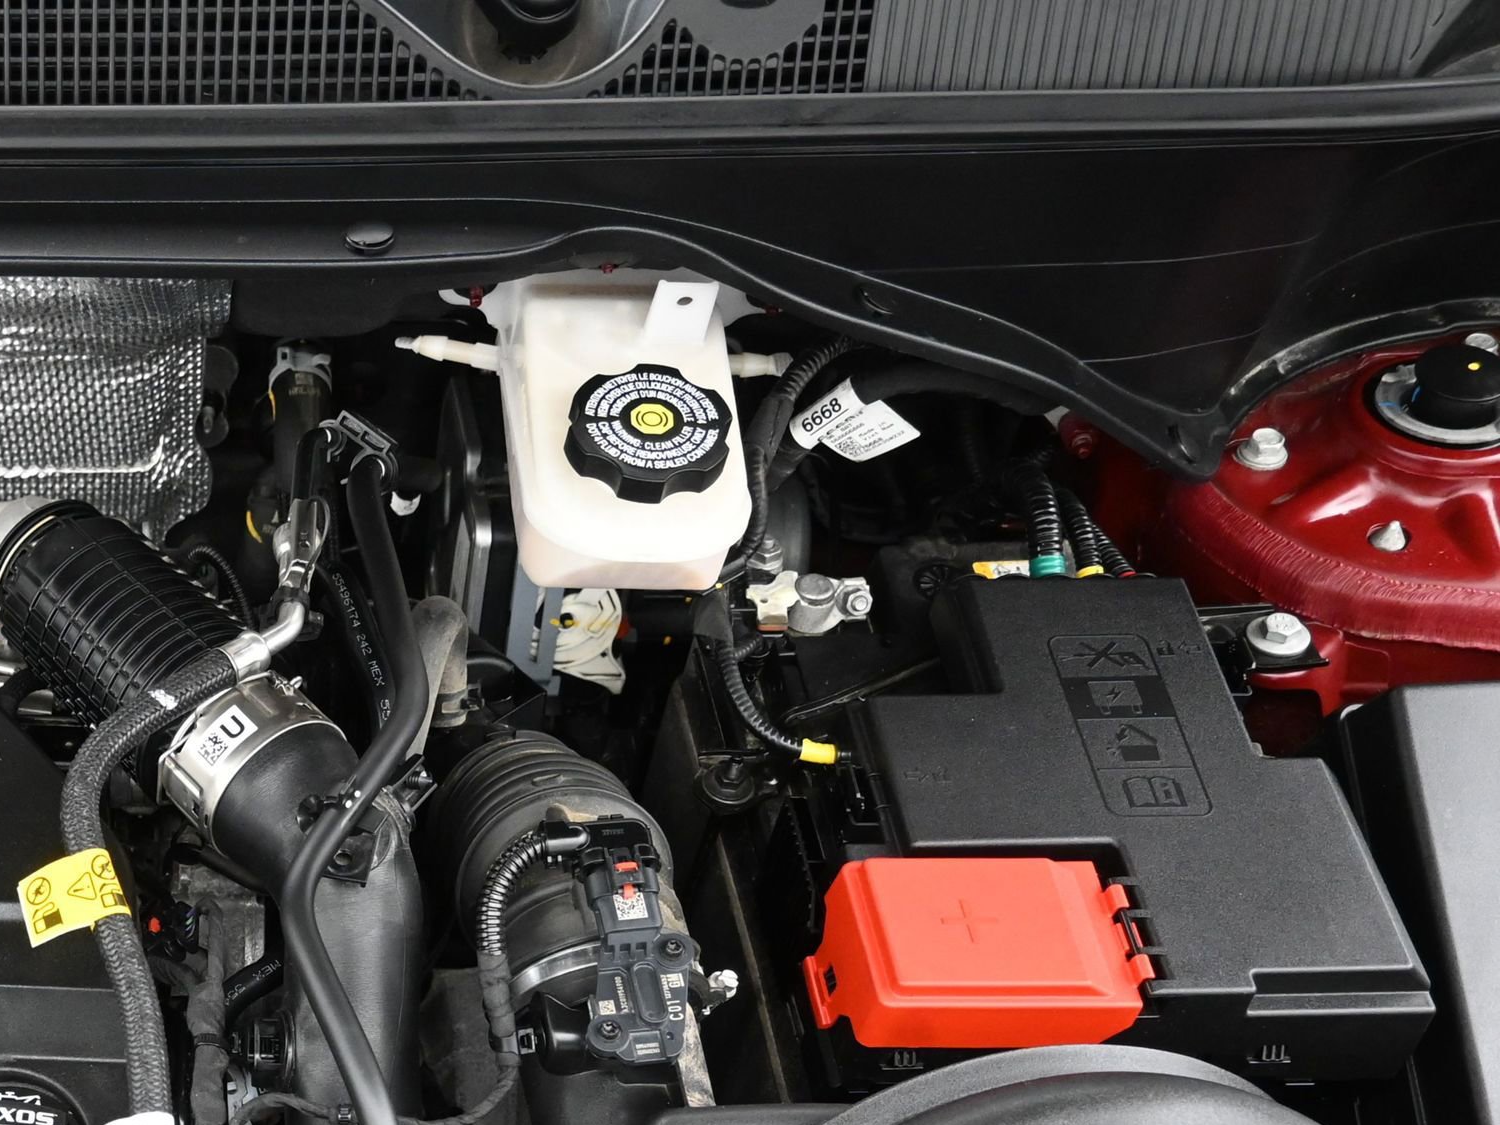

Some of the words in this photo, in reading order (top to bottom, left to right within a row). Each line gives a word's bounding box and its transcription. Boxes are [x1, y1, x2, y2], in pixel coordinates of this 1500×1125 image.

[649, 373, 684, 388] BOUCHON
[802, 398, 842, 432] 6668
[606, 433, 637, 456] BEFORE
[644, 441, 674, 450] CLEAN
[672, 426, 694, 446] FILLER
[597, 439, 621, 457] FLUID
[619, 453, 646, 468] FROM
[646, 460, 653, 469] A
[654, 456, 688, 469] SEALED
[332, 572, 361, 628] 55496174
[356, 634, 372, 656] 242
[368, 660, 385, 687] MEX
[220, 715, 245, 739] U
[252, 960, 282, 981] MEX
[669, 974, 683, 988] GM
